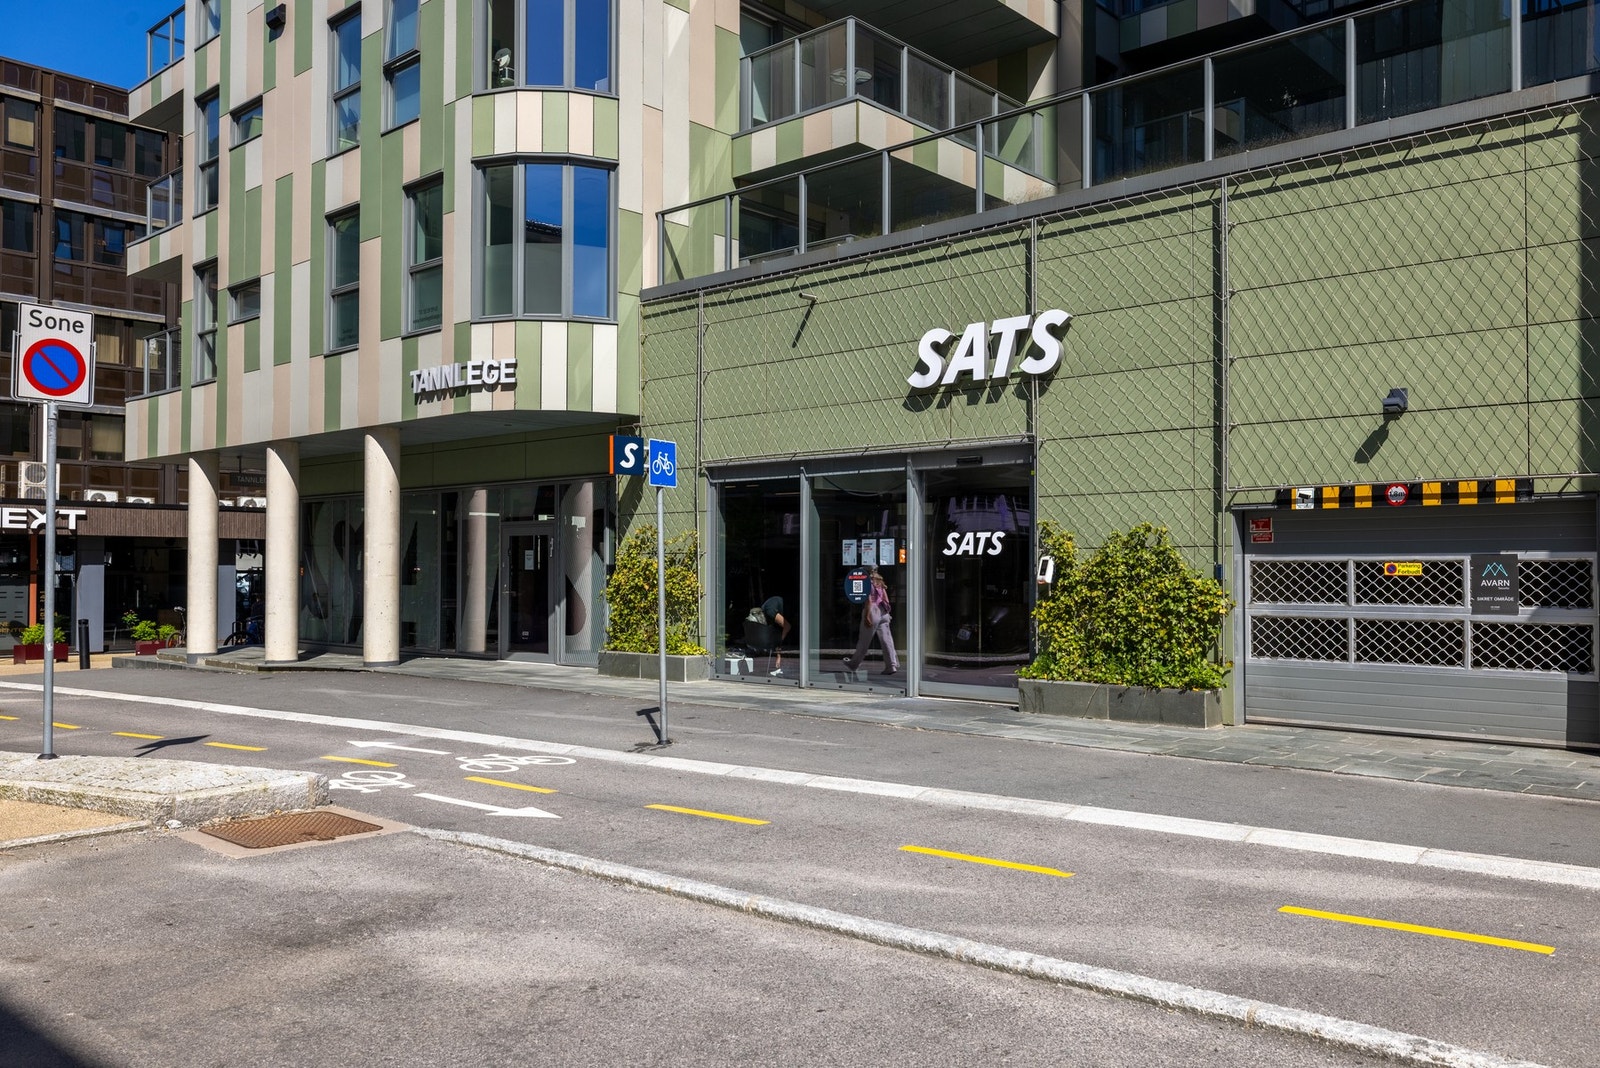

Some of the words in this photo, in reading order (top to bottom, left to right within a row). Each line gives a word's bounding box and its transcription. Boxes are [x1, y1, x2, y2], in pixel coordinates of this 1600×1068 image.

[28, 309, 85, 334] Sone
[906, 309, 1073, 389] SATS
[409, 358, 518, 394] TANNLEGE
[619, 442, 639, 469] S
[237, 475, 266, 484] TANNLE
[0, 507, 87, 530] EXT
[942, 531, 1006, 556] SATS
[1480, 579, 1510, 587] AVARN
